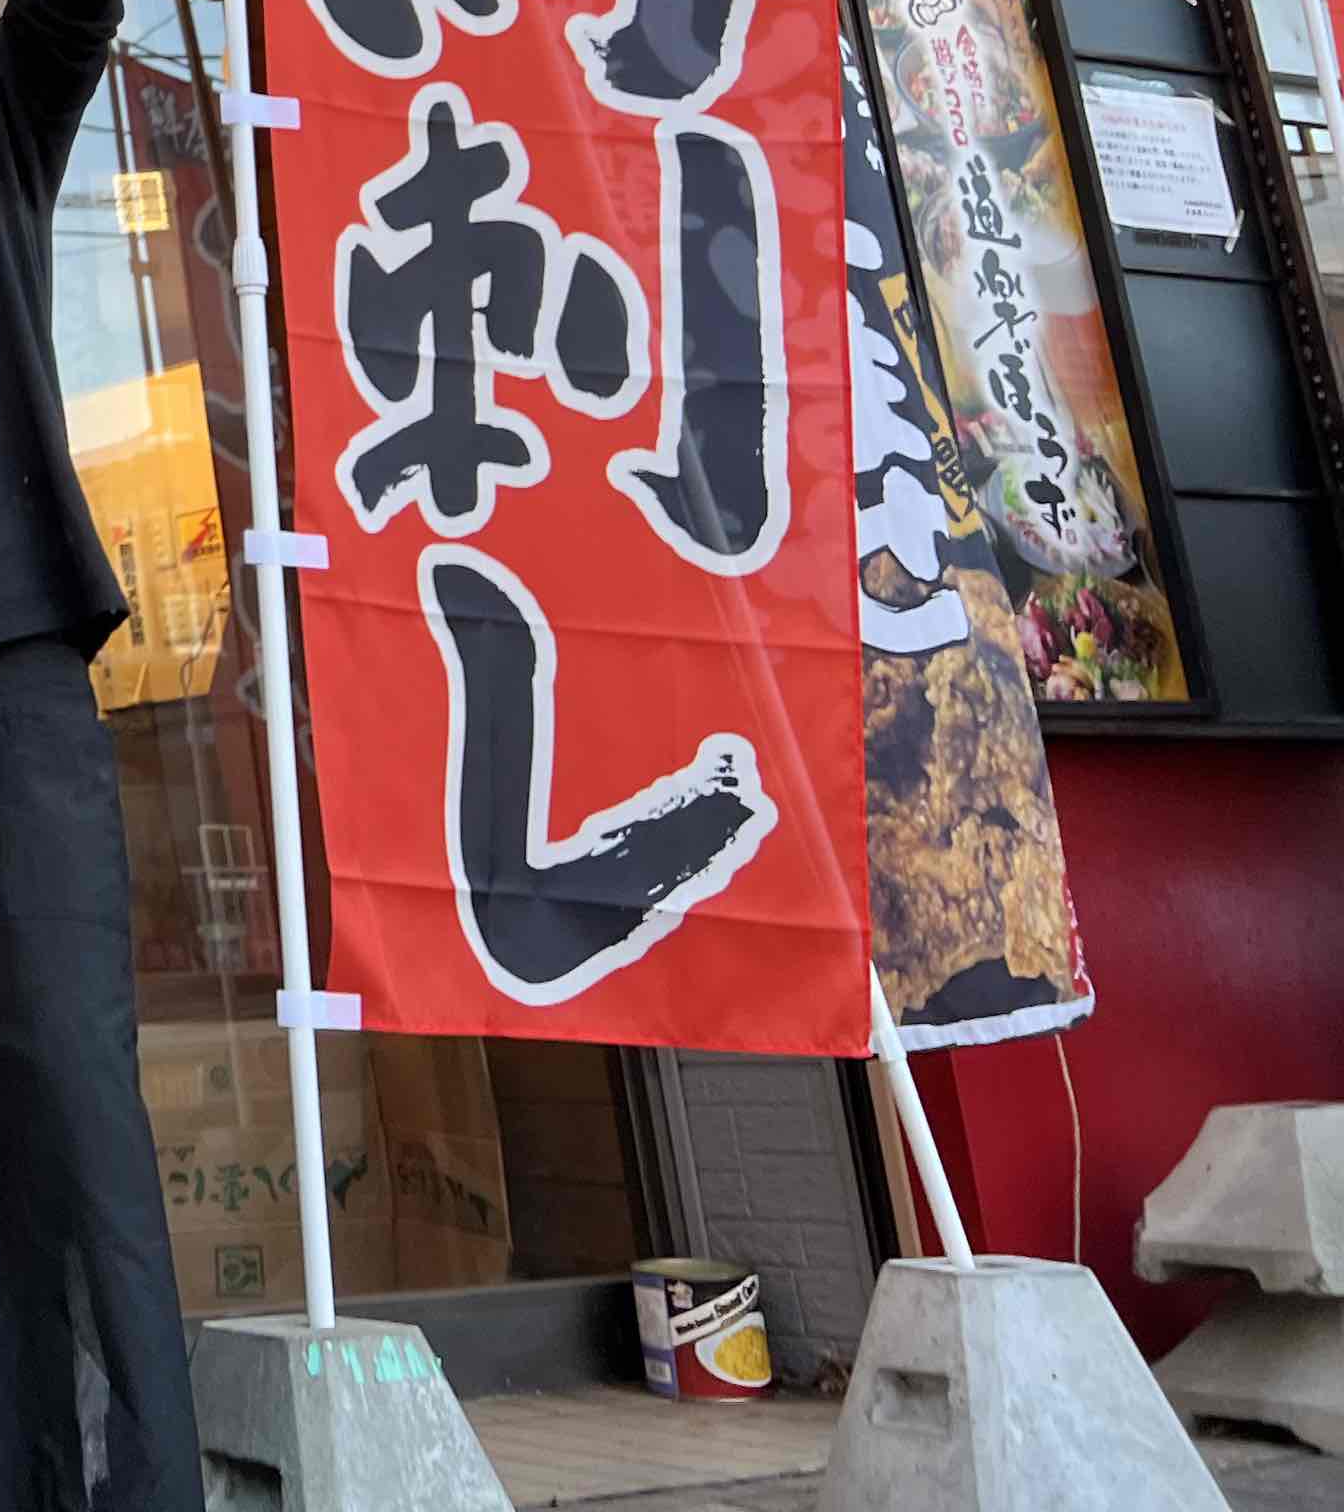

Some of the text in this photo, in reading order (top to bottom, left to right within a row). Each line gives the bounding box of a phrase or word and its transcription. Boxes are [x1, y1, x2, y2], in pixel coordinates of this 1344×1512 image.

[957, 154, 1076, 539] 道楽ぼうず
